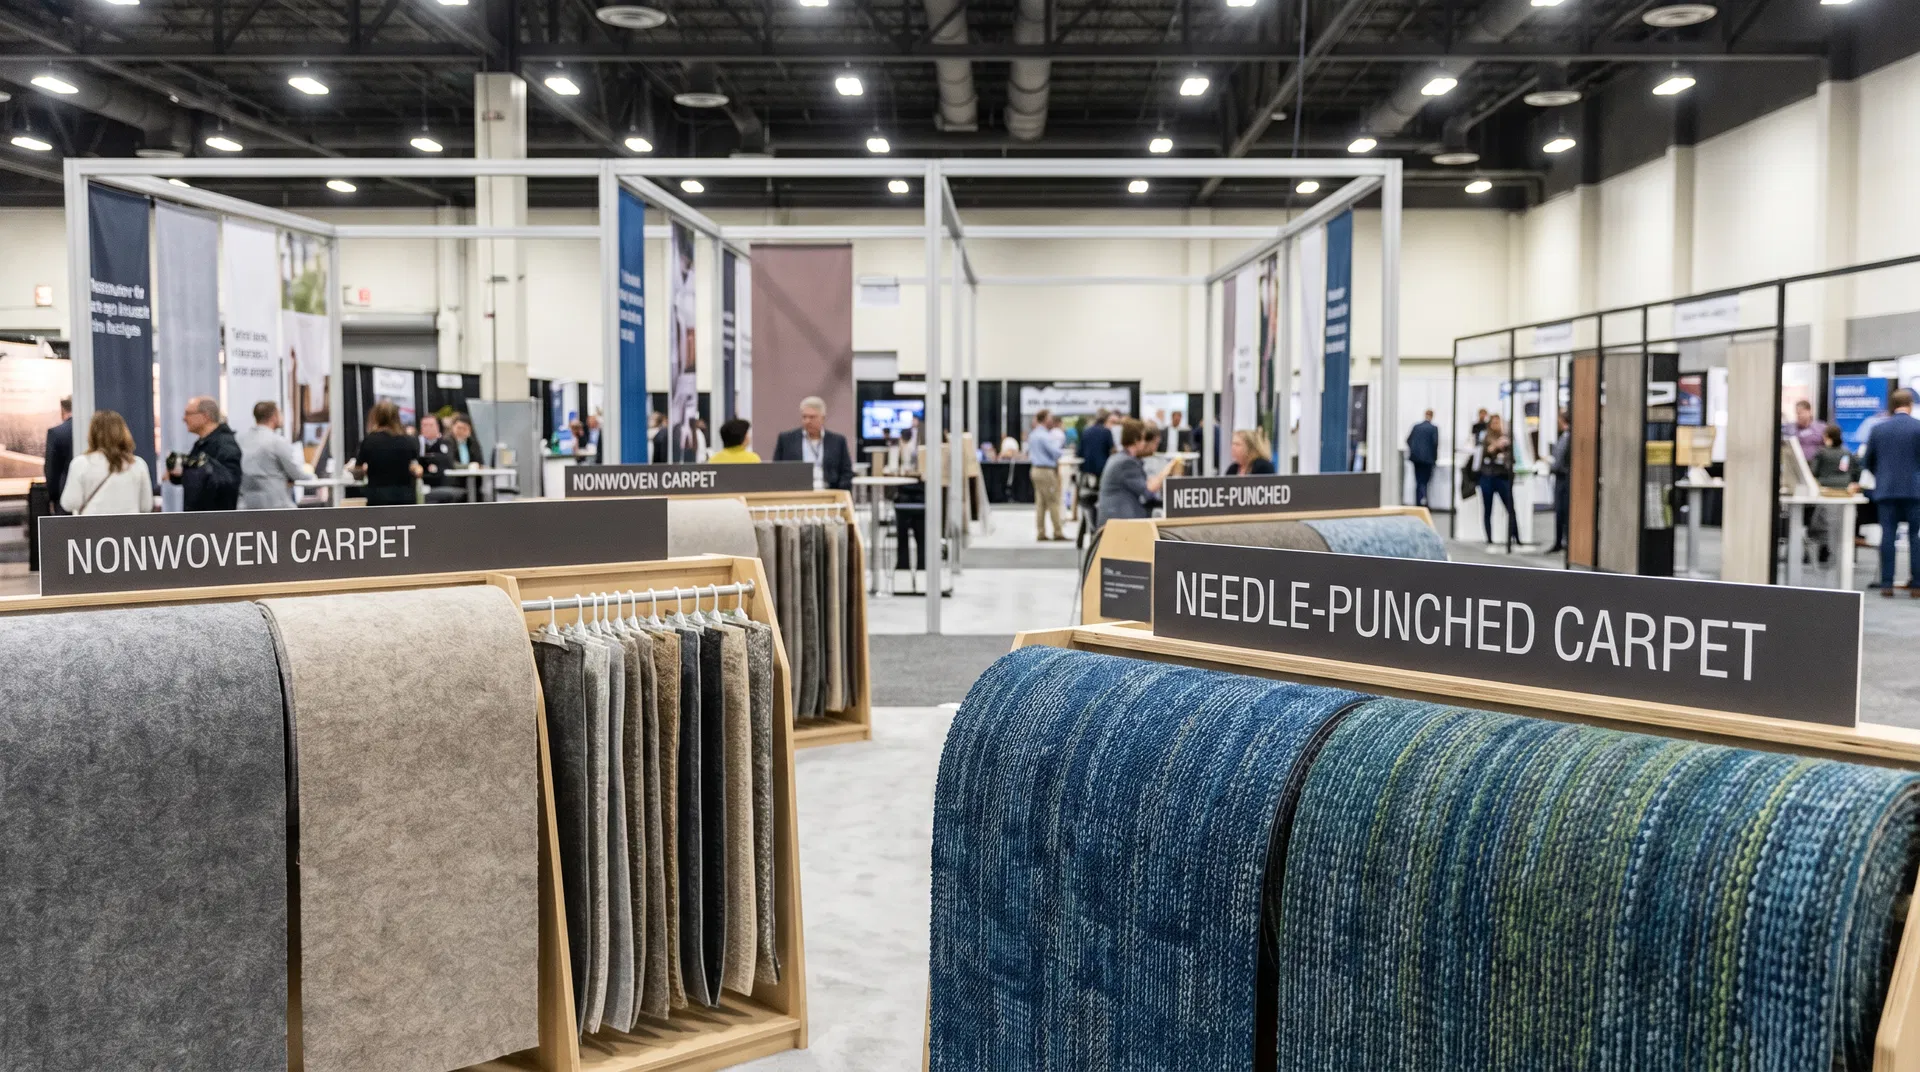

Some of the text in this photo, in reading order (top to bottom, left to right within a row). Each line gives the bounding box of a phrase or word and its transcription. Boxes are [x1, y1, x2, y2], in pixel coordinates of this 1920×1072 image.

[573, 470, 718, 491] NONWOVEN CARPET
[1174, 485, 1290, 508] NEEDLE-PUNCHED
[68, 525, 415, 574] NONWOVEN CARPET
[1175, 570, 1766, 681] NEEDLE-PUNCHED CARPET
